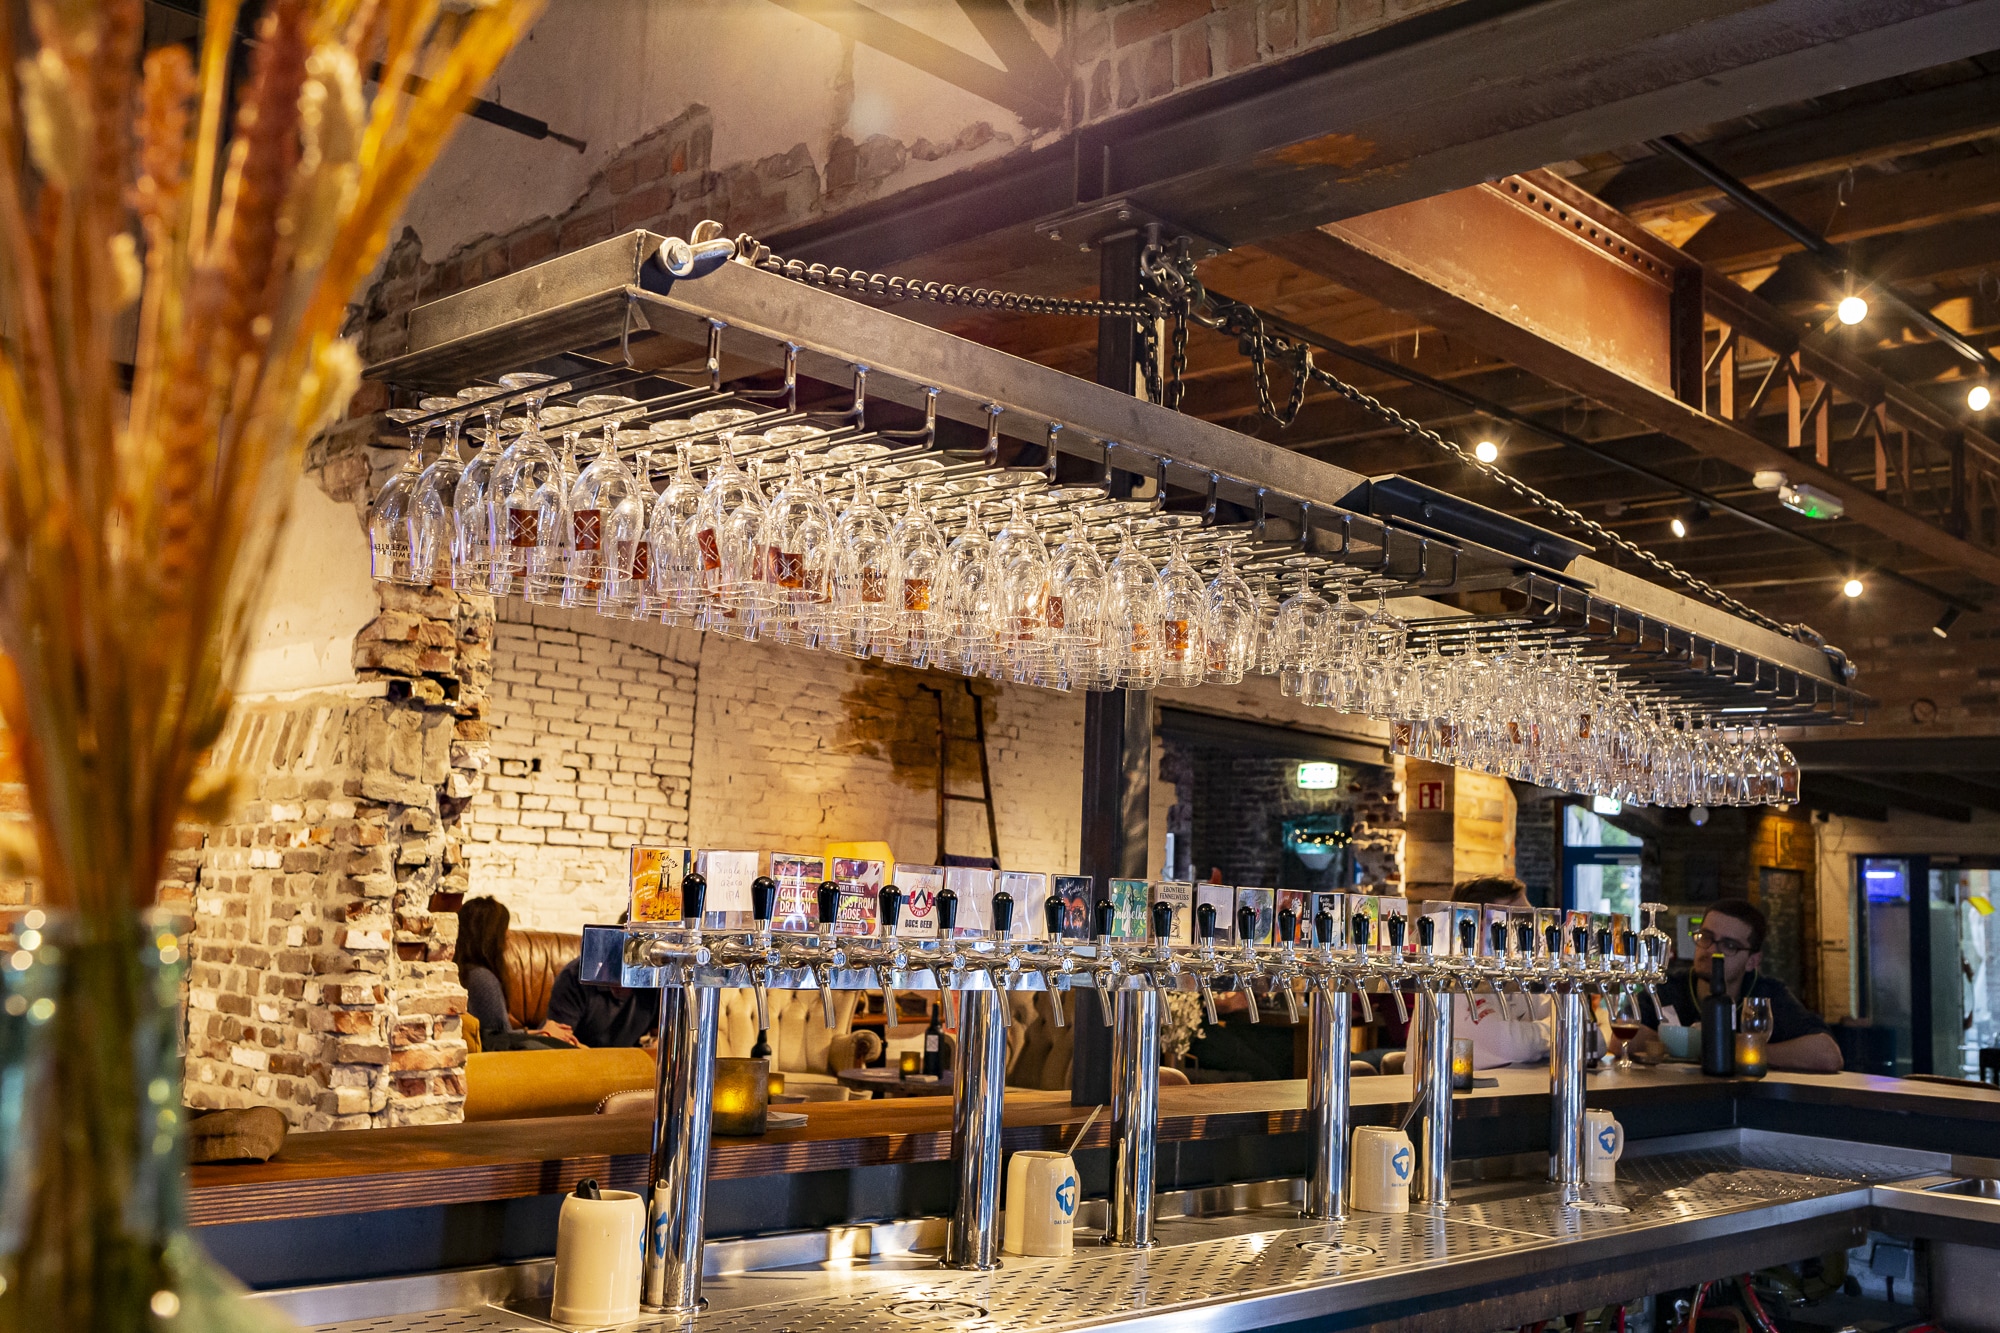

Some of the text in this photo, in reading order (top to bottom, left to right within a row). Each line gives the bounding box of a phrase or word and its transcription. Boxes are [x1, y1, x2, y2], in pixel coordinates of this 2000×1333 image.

[646, 851, 678, 869] Hi Johnny
[781, 888, 815, 902] GALCTIC
[842, 907, 860, 921] ROSE
